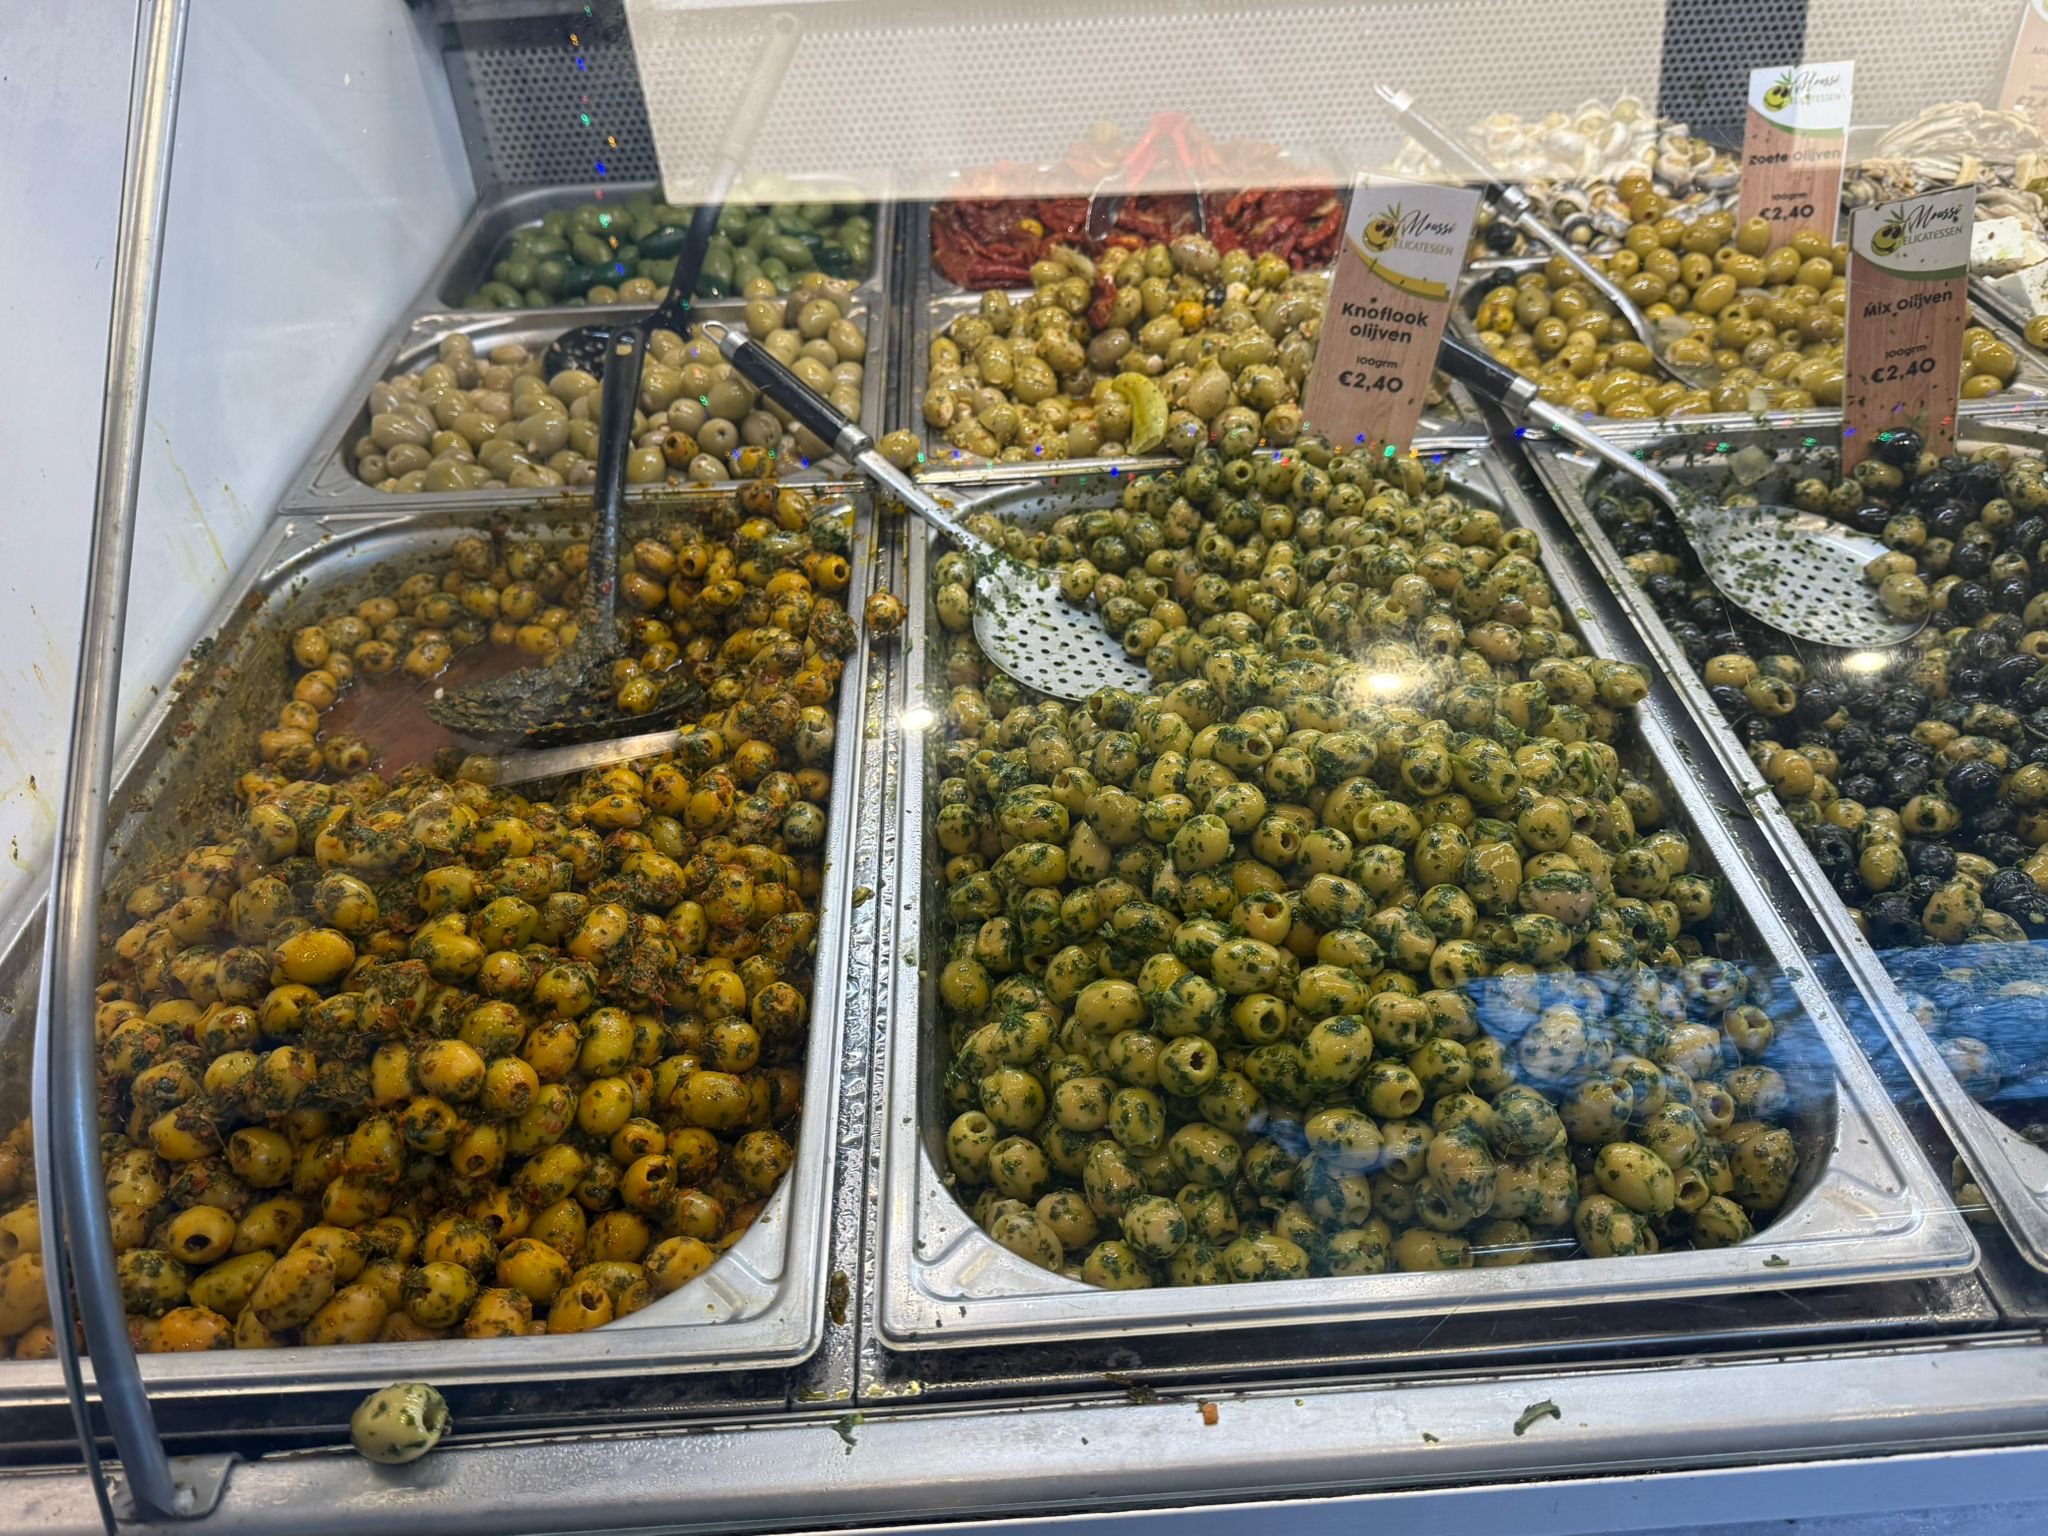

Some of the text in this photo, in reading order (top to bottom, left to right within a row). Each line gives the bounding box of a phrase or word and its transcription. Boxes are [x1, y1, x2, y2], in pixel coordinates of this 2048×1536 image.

[1748, 148, 1841, 166] Zoete Olijven
[1759, 204, 1815, 220] €2,40
[1341, 302, 1429, 328] Knoflook
[1863, 290, 1953, 319] Mix Olijven
[1350, 322, 1412, 344] olijven
[1356, 355, 1398, 369] 100grm
[1885, 344, 1928, 360] 100grm
[1871, 357, 1937, 384] €2,40
[1338, 370, 1404, 394] €2,40
